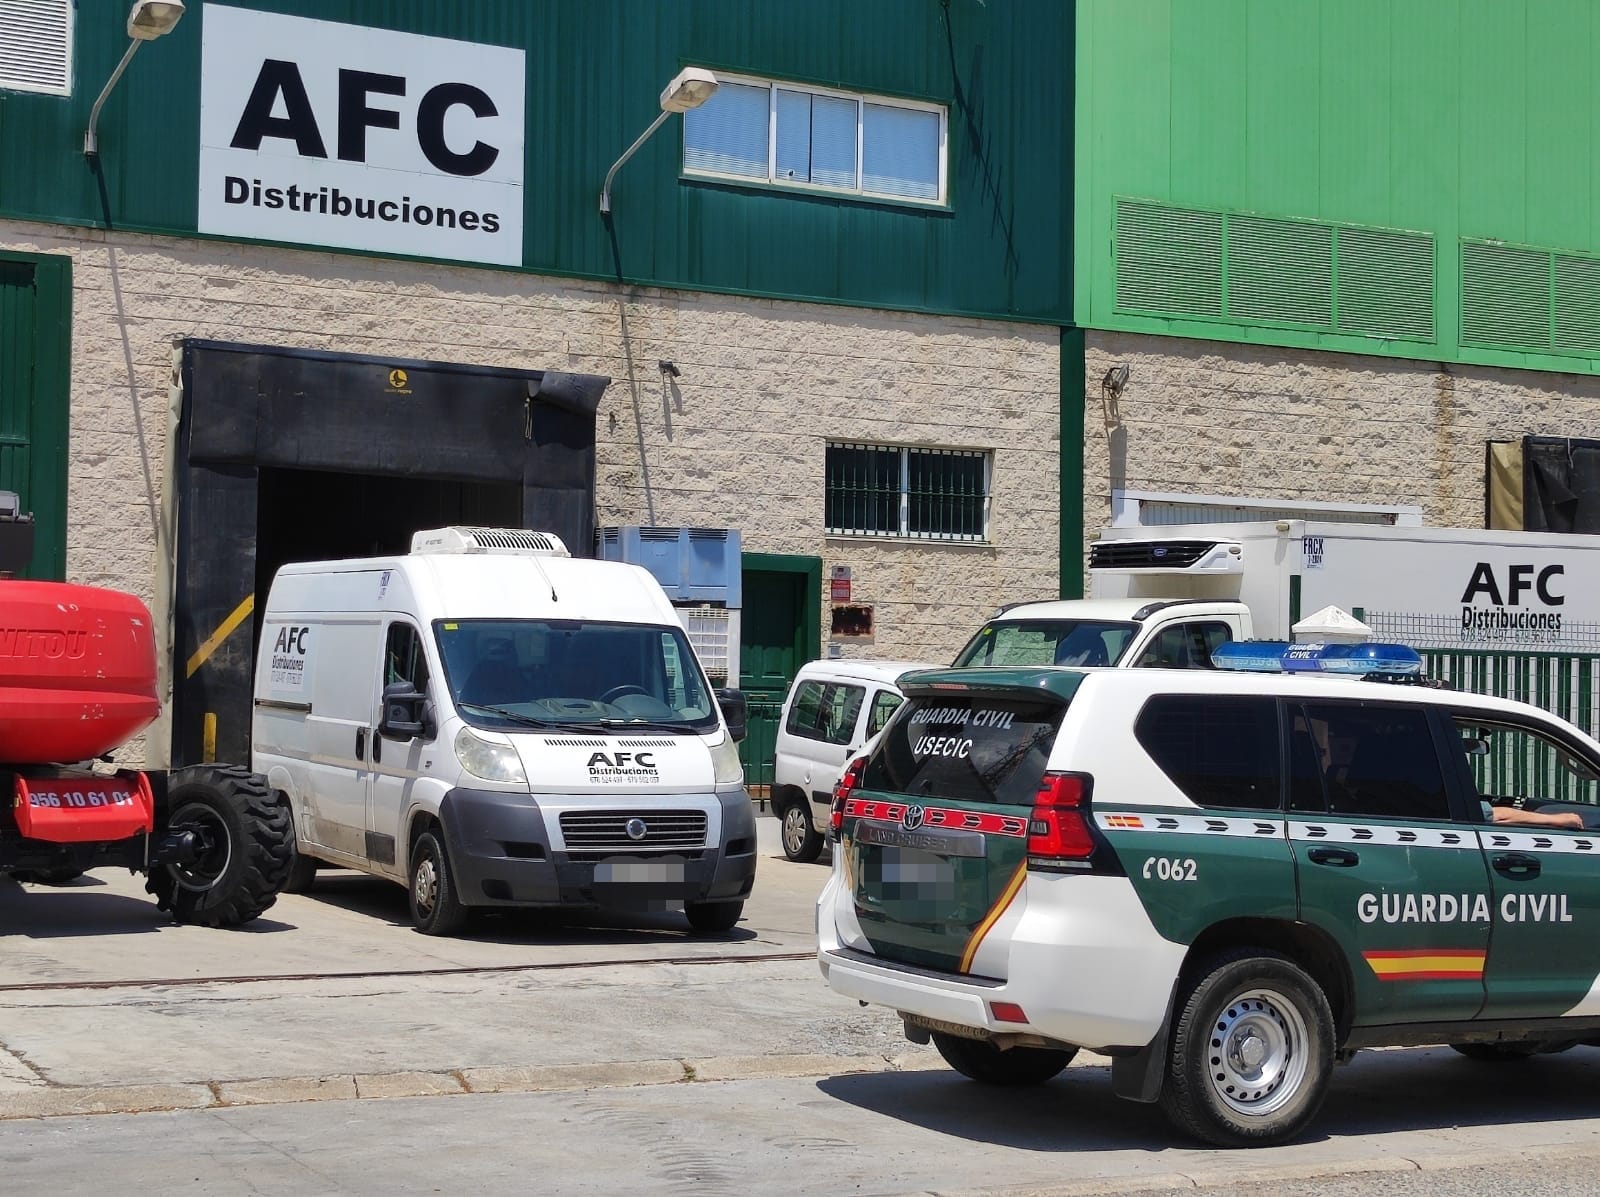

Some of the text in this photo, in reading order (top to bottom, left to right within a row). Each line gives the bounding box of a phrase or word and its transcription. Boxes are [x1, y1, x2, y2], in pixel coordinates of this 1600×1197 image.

[229, 58, 500, 177] AFC
[224, 175, 501, 233] Distribuciones
[1303, 537, 1323, 555] FRCX
[1460, 562, 1565, 606] AFC
[1462, 606, 1562, 630] Distribuciones
[273, 626, 310, 655] AFC
[1290, 651, 1311, 659] CIVIL
[911, 707, 1015, 730] GUARDIA CIVIL
[914, 735, 973, 759] USECIC
[586, 752, 656, 767] AFC
[589, 767, 659, 775] Distribuciones
[29, 791, 134, 808] 956 10 61 01
[1157, 857, 1198, 881] 062
[1357, 893, 1573, 923] GUARDIA CIVIL
